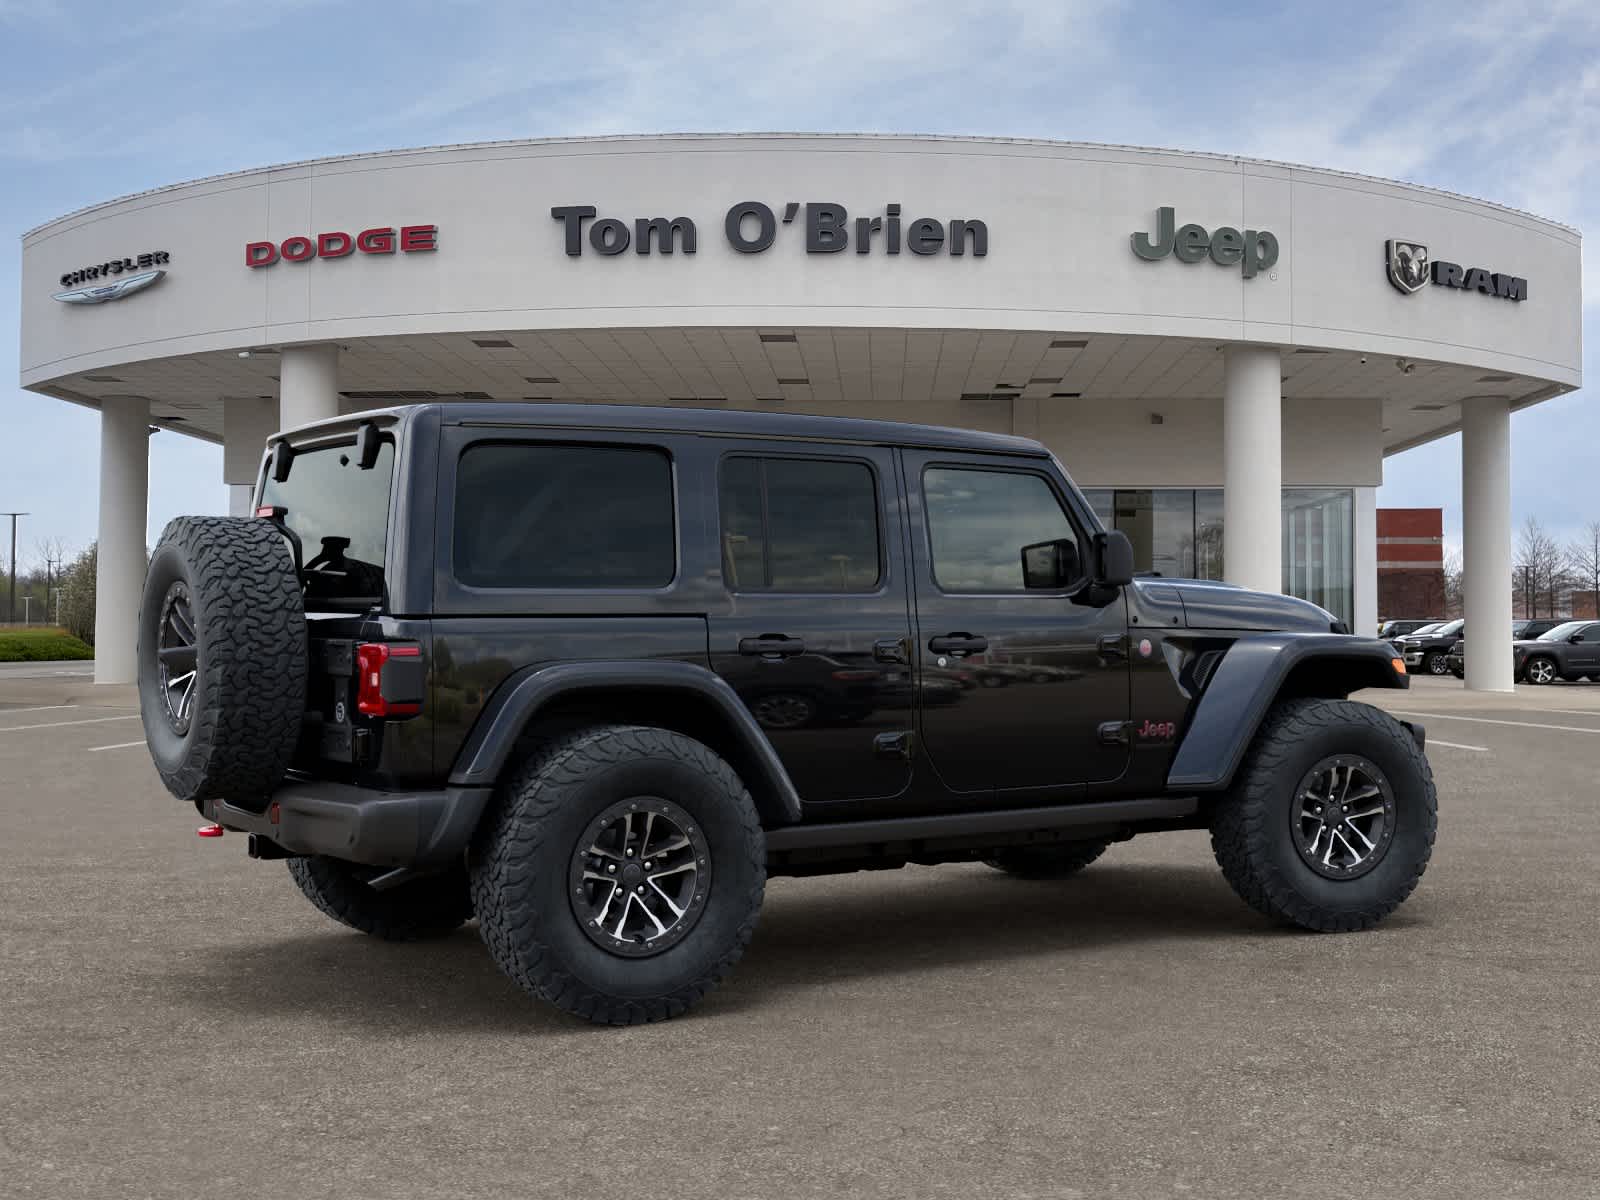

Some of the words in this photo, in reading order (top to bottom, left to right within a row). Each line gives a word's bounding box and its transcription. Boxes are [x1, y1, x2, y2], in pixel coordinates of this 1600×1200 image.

[246, 224, 438, 268] DODGE
[551, 205, 697, 256] Tom
[724, 201, 988, 256] O'Brien
[1130, 206, 1280, 279] Jeep
[60, 250, 170, 287] CHRYSLER
[1430, 261, 1528, 301] RAM
[1137, 720, 1176, 739] Jeep
